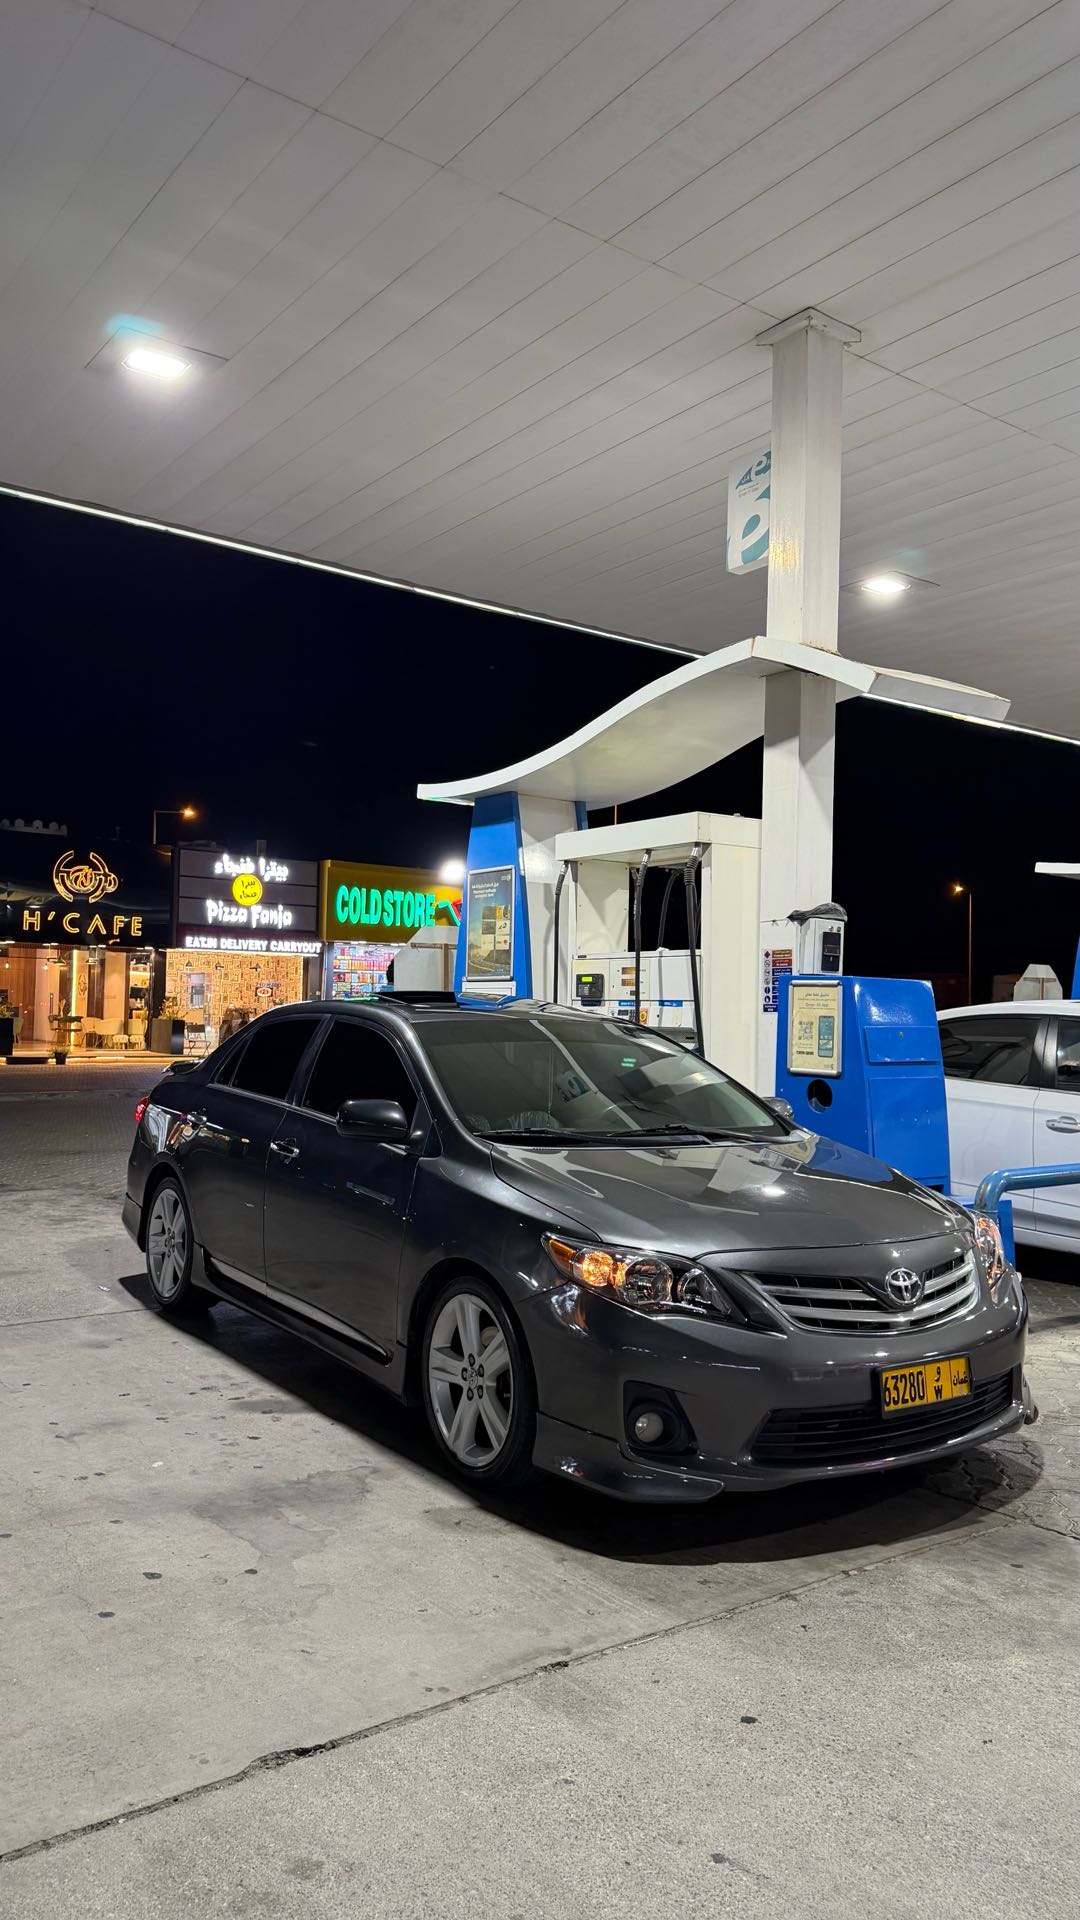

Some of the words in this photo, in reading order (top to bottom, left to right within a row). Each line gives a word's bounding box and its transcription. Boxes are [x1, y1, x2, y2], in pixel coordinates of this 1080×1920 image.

[206, 899, 248, 924] Pizza
[250, 904, 293, 929] Fanja
[336, 885, 381, 924] COLD
[382, 889, 436, 927] STORE
[220, 938, 268, 951] DELIVERY
[270, 941, 322, 954] CARRYOUT
[883, 1370, 925, 1407] 63280
[933, 1384, 943, 1400] W
